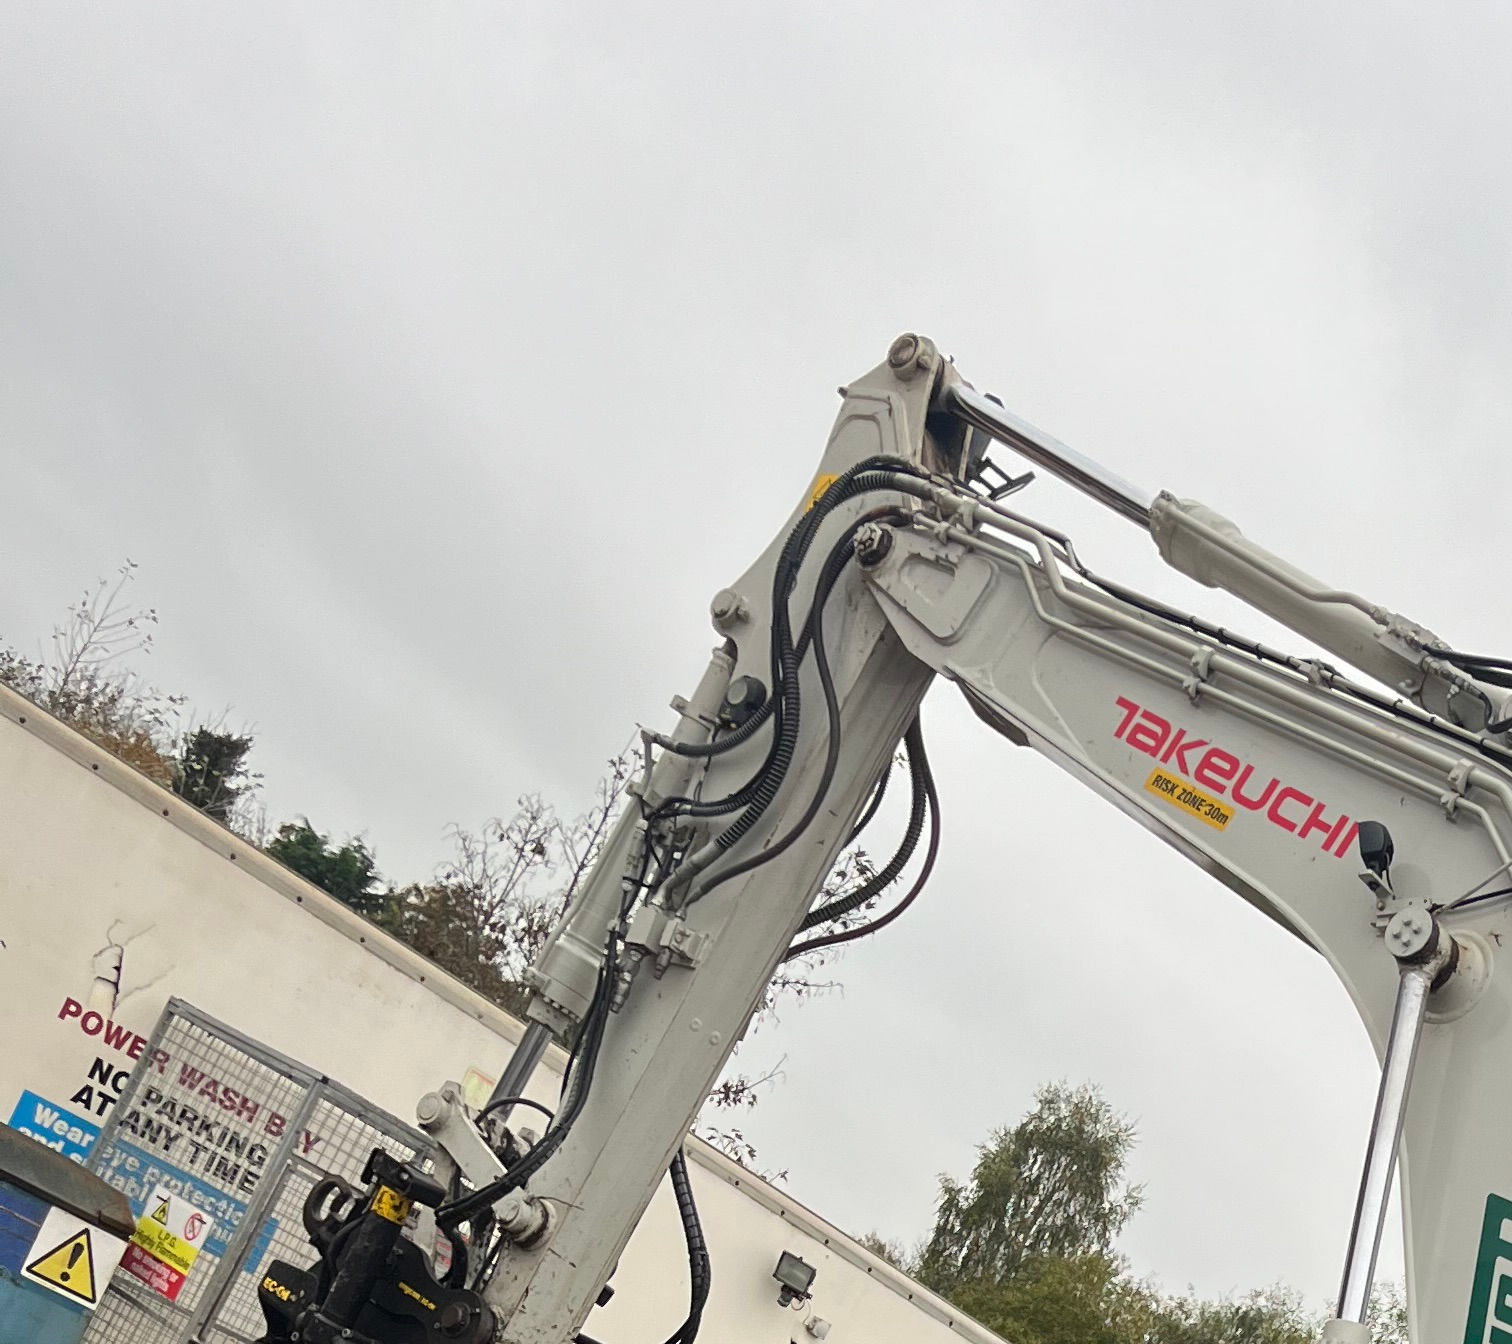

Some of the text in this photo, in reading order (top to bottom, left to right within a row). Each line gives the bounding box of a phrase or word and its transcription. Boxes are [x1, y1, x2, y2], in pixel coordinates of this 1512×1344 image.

[1151, 773, 1229, 826] RISK ZONE 30m
[58, 997, 320, 1155] POWER WASH BY
[34, 1102, 97, 1148] Wear
[70, 1084, 261, 1195] AT ANY TIME
[141, 1085, 269, 1170] PARKING
